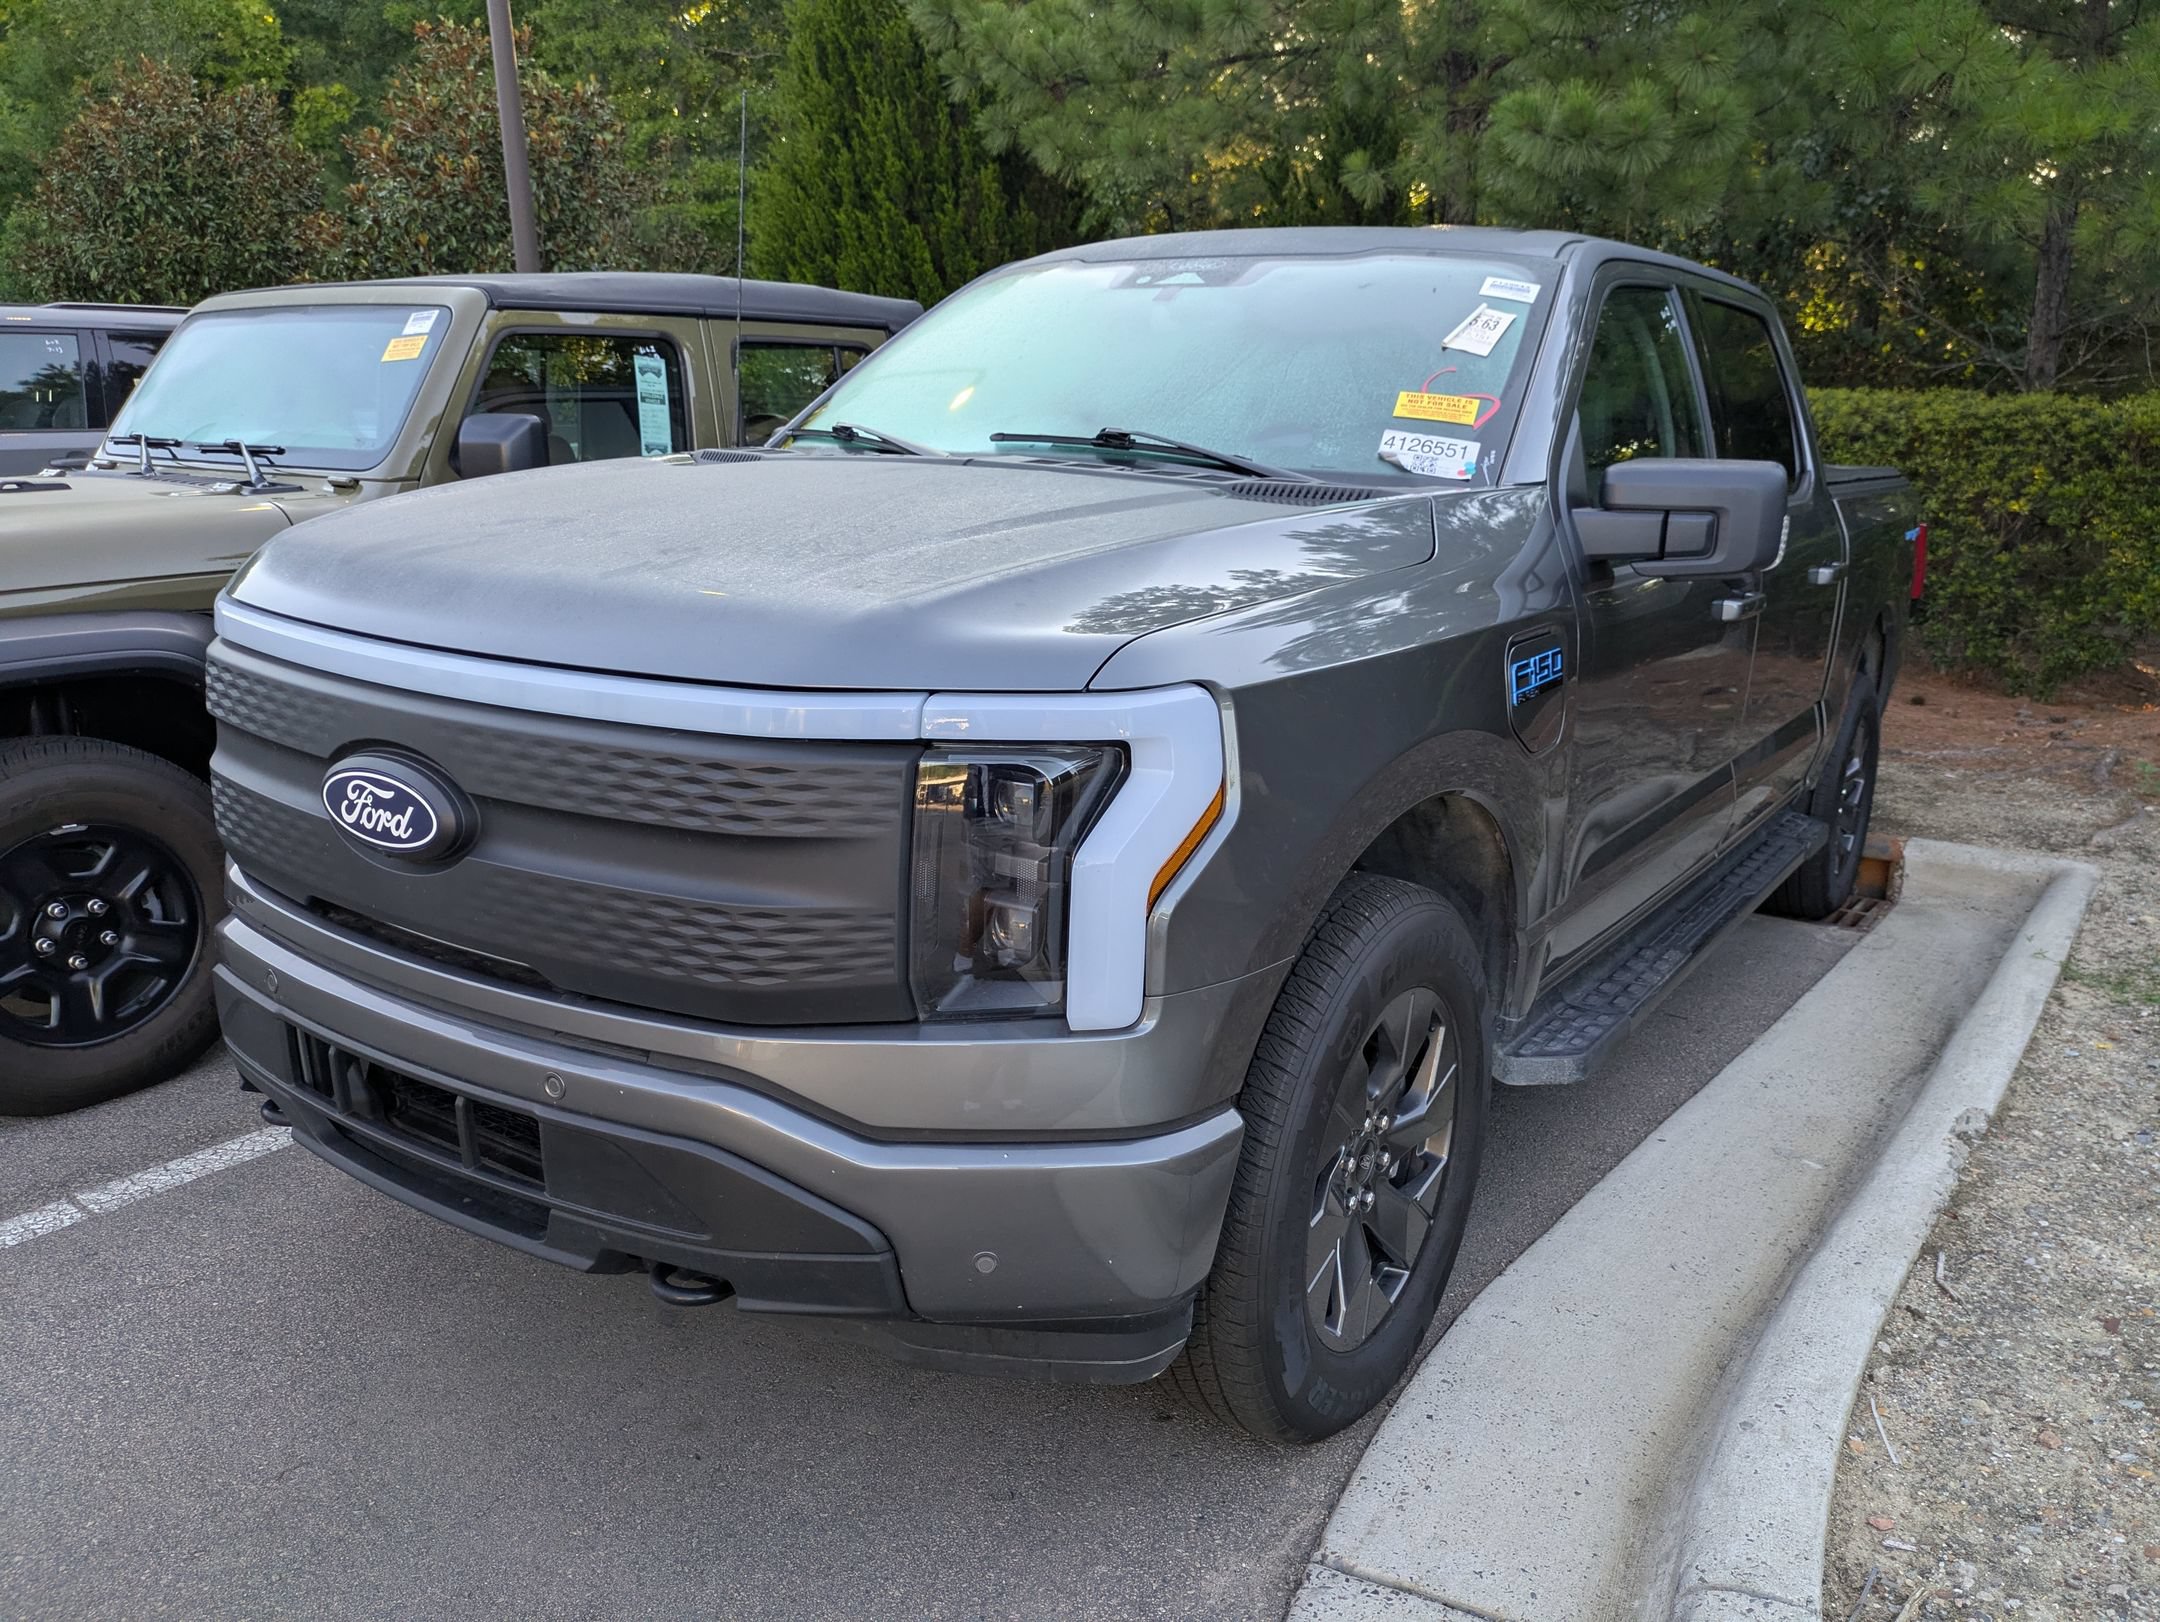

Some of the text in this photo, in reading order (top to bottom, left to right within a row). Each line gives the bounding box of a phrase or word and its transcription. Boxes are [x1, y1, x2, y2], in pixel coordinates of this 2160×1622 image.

[1427, 395, 1463, 404] VEHICLE
[1446, 402, 1468, 410] SALE
[1384, 436, 1468, 460] 4126551
[341, 780, 414, 839] Ford
